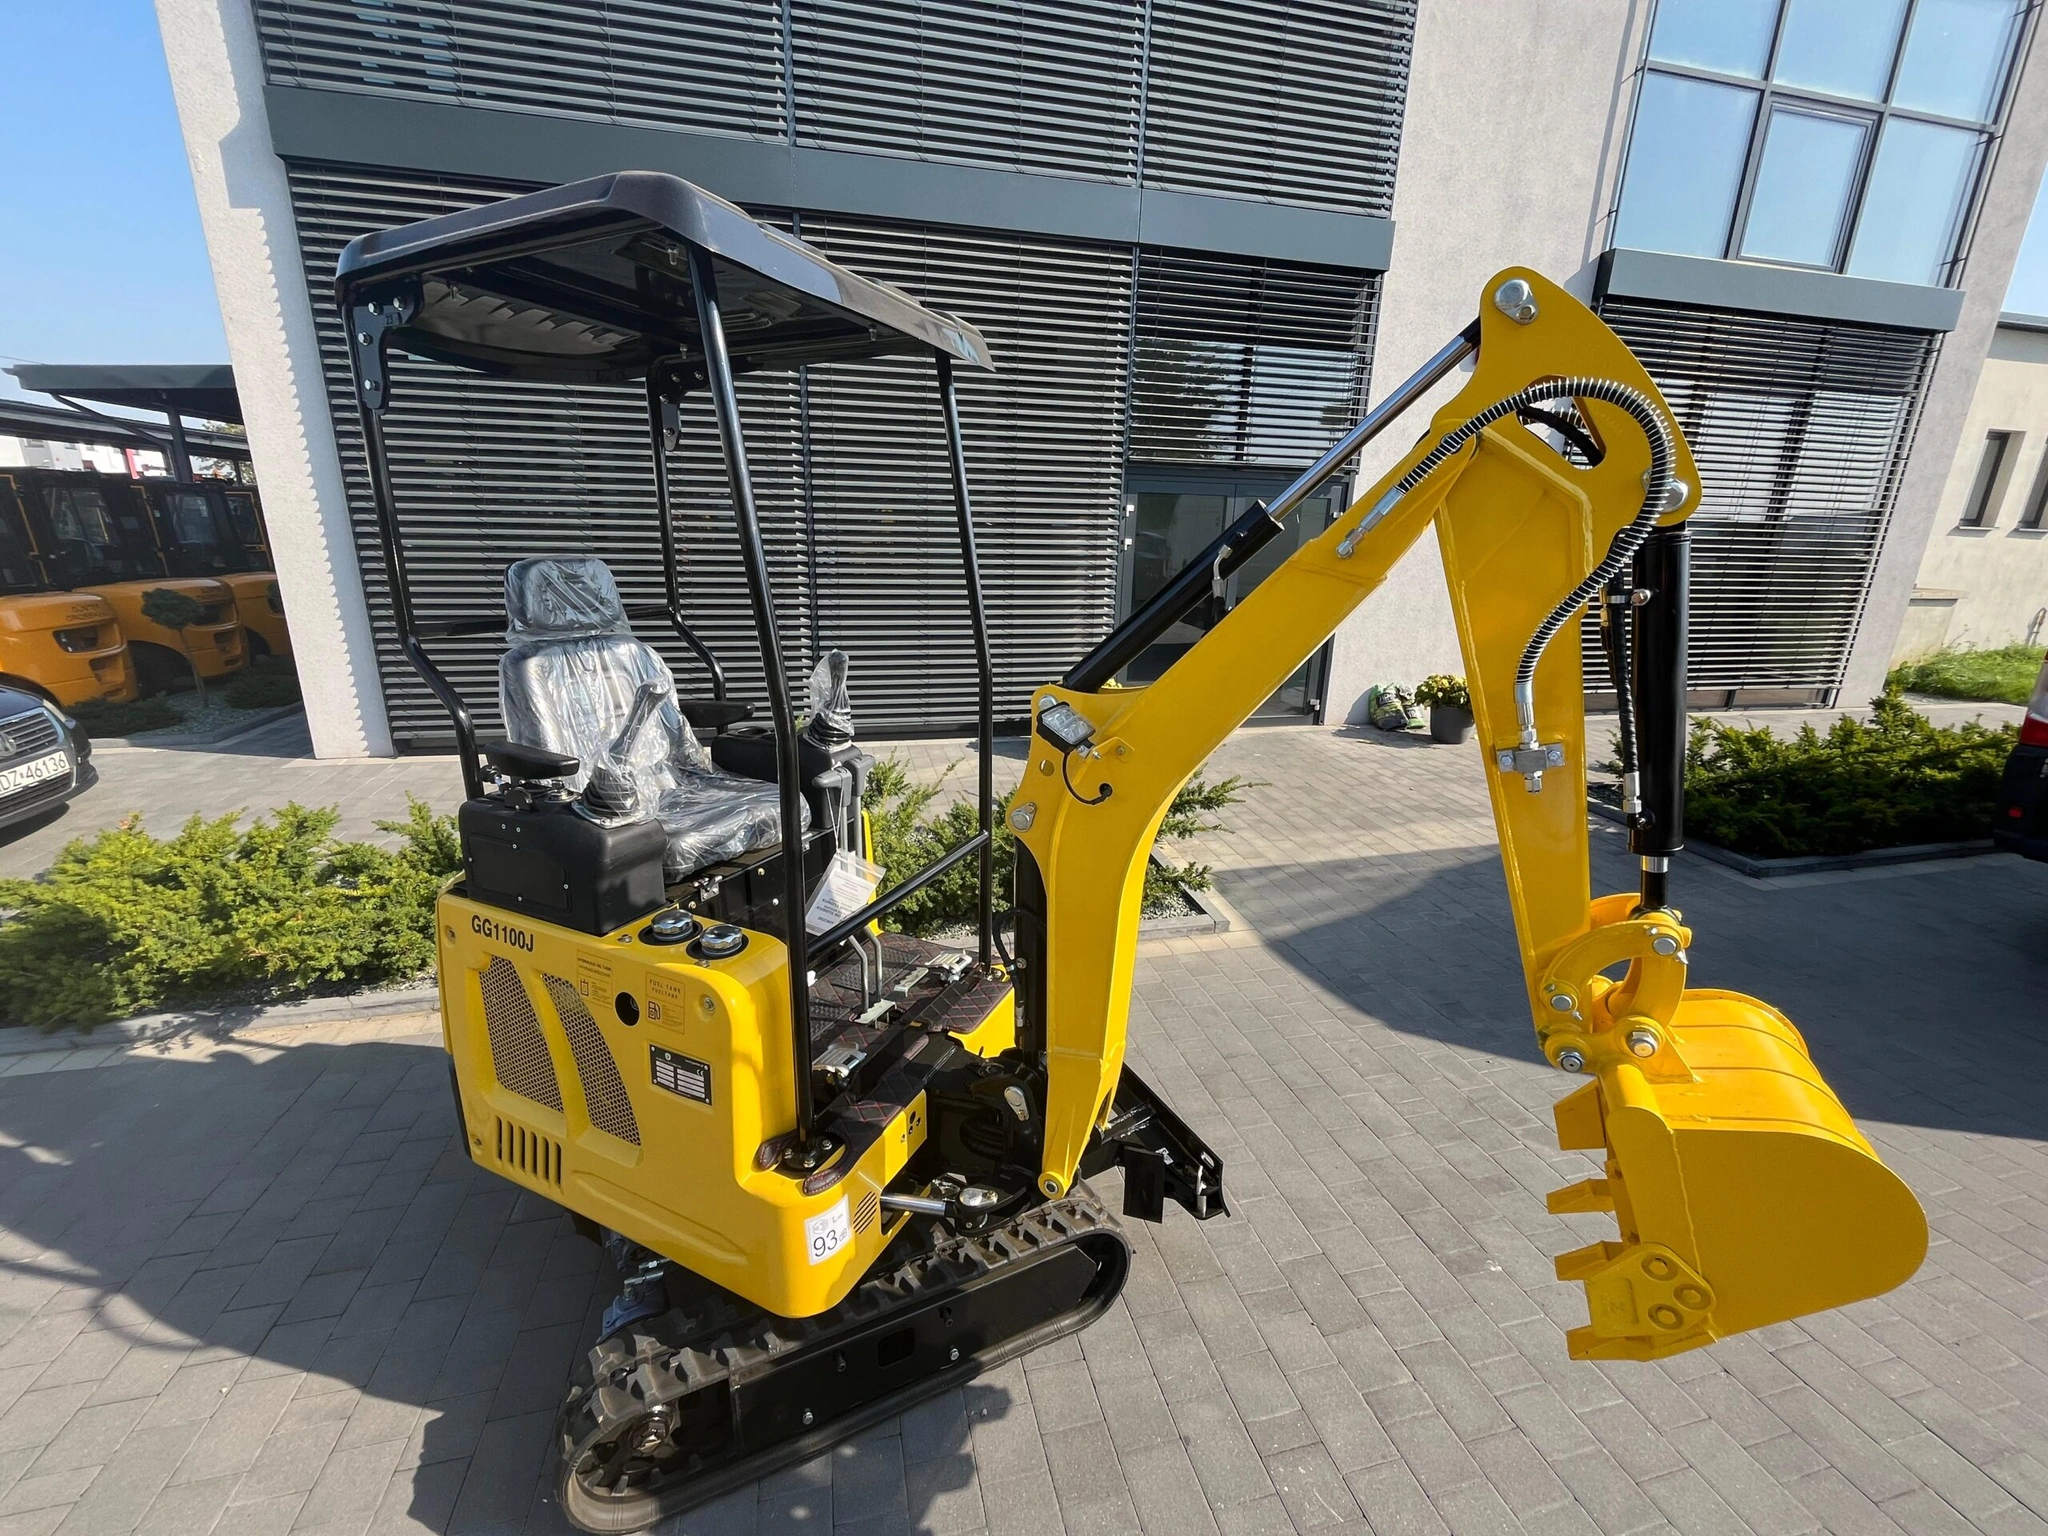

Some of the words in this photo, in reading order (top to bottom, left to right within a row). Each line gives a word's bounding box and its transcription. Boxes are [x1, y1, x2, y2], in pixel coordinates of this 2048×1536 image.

[0, 770, 22, 792] DZ
[26, 754, 66, 780] 46136
[471, 914, 534, 952] GG1100J
[649, 979, 663, 989] FUEL
[666, 984, 681, 995] TANK
[813, 1229, 838, 1257] 93
